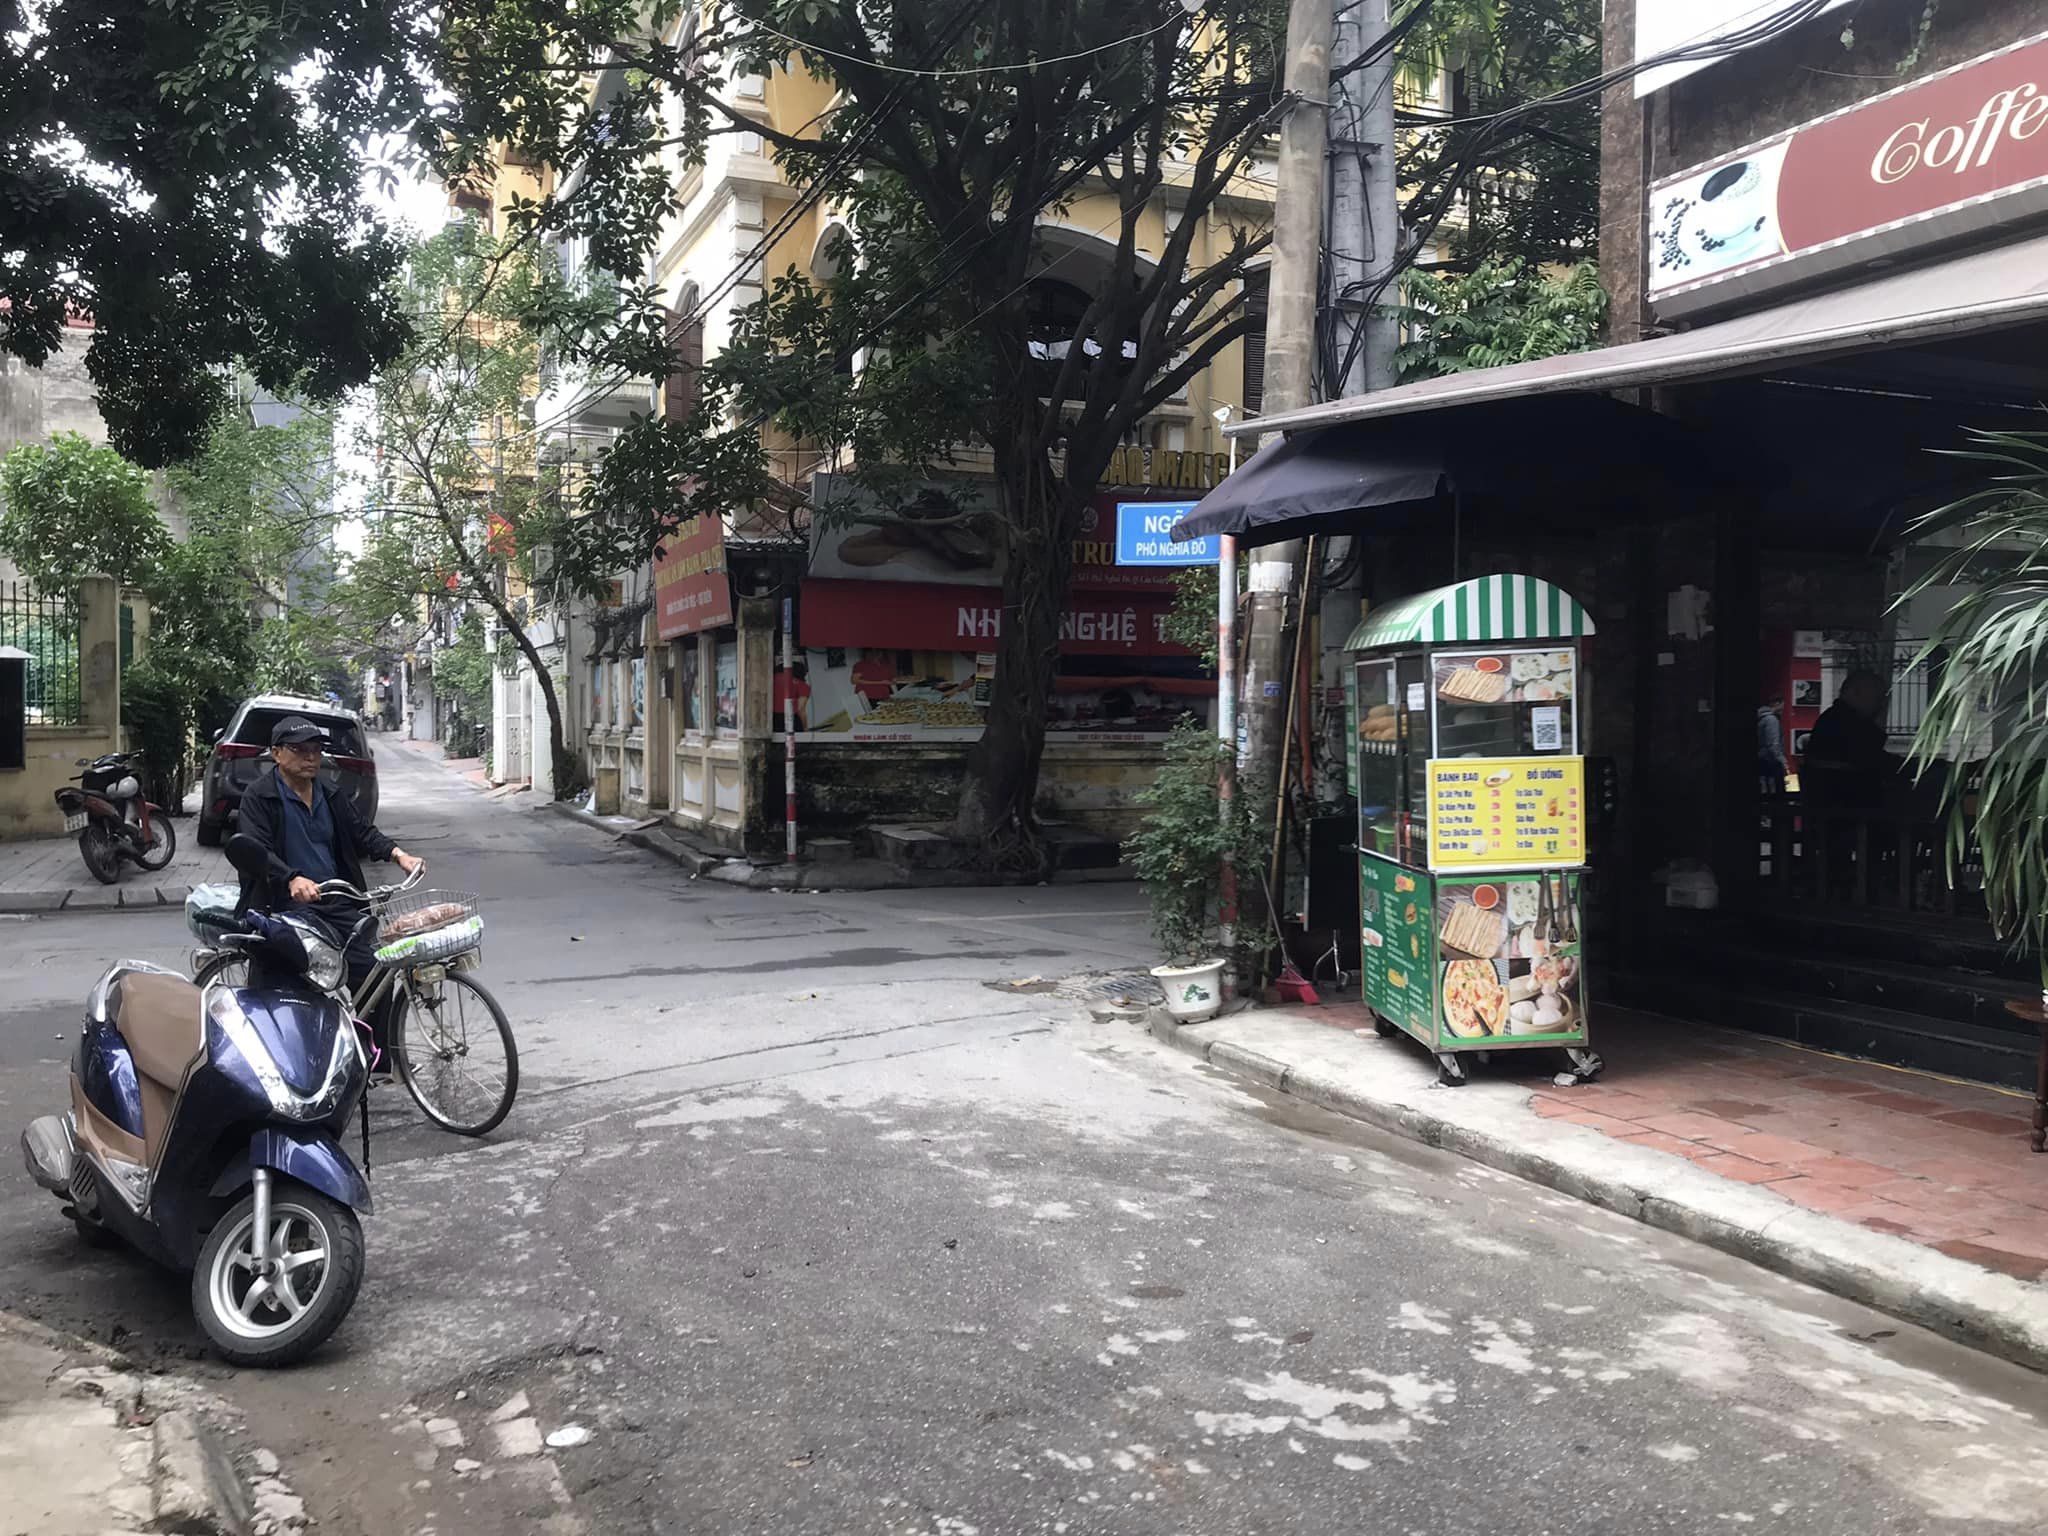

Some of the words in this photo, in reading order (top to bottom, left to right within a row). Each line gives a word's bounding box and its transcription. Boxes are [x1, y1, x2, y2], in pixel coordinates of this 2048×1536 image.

[1099, 447, 1144, 486] AO
[1072, 540, 1114, 565] TRU
[1057, 607, 1137, 647] NGHỆ
